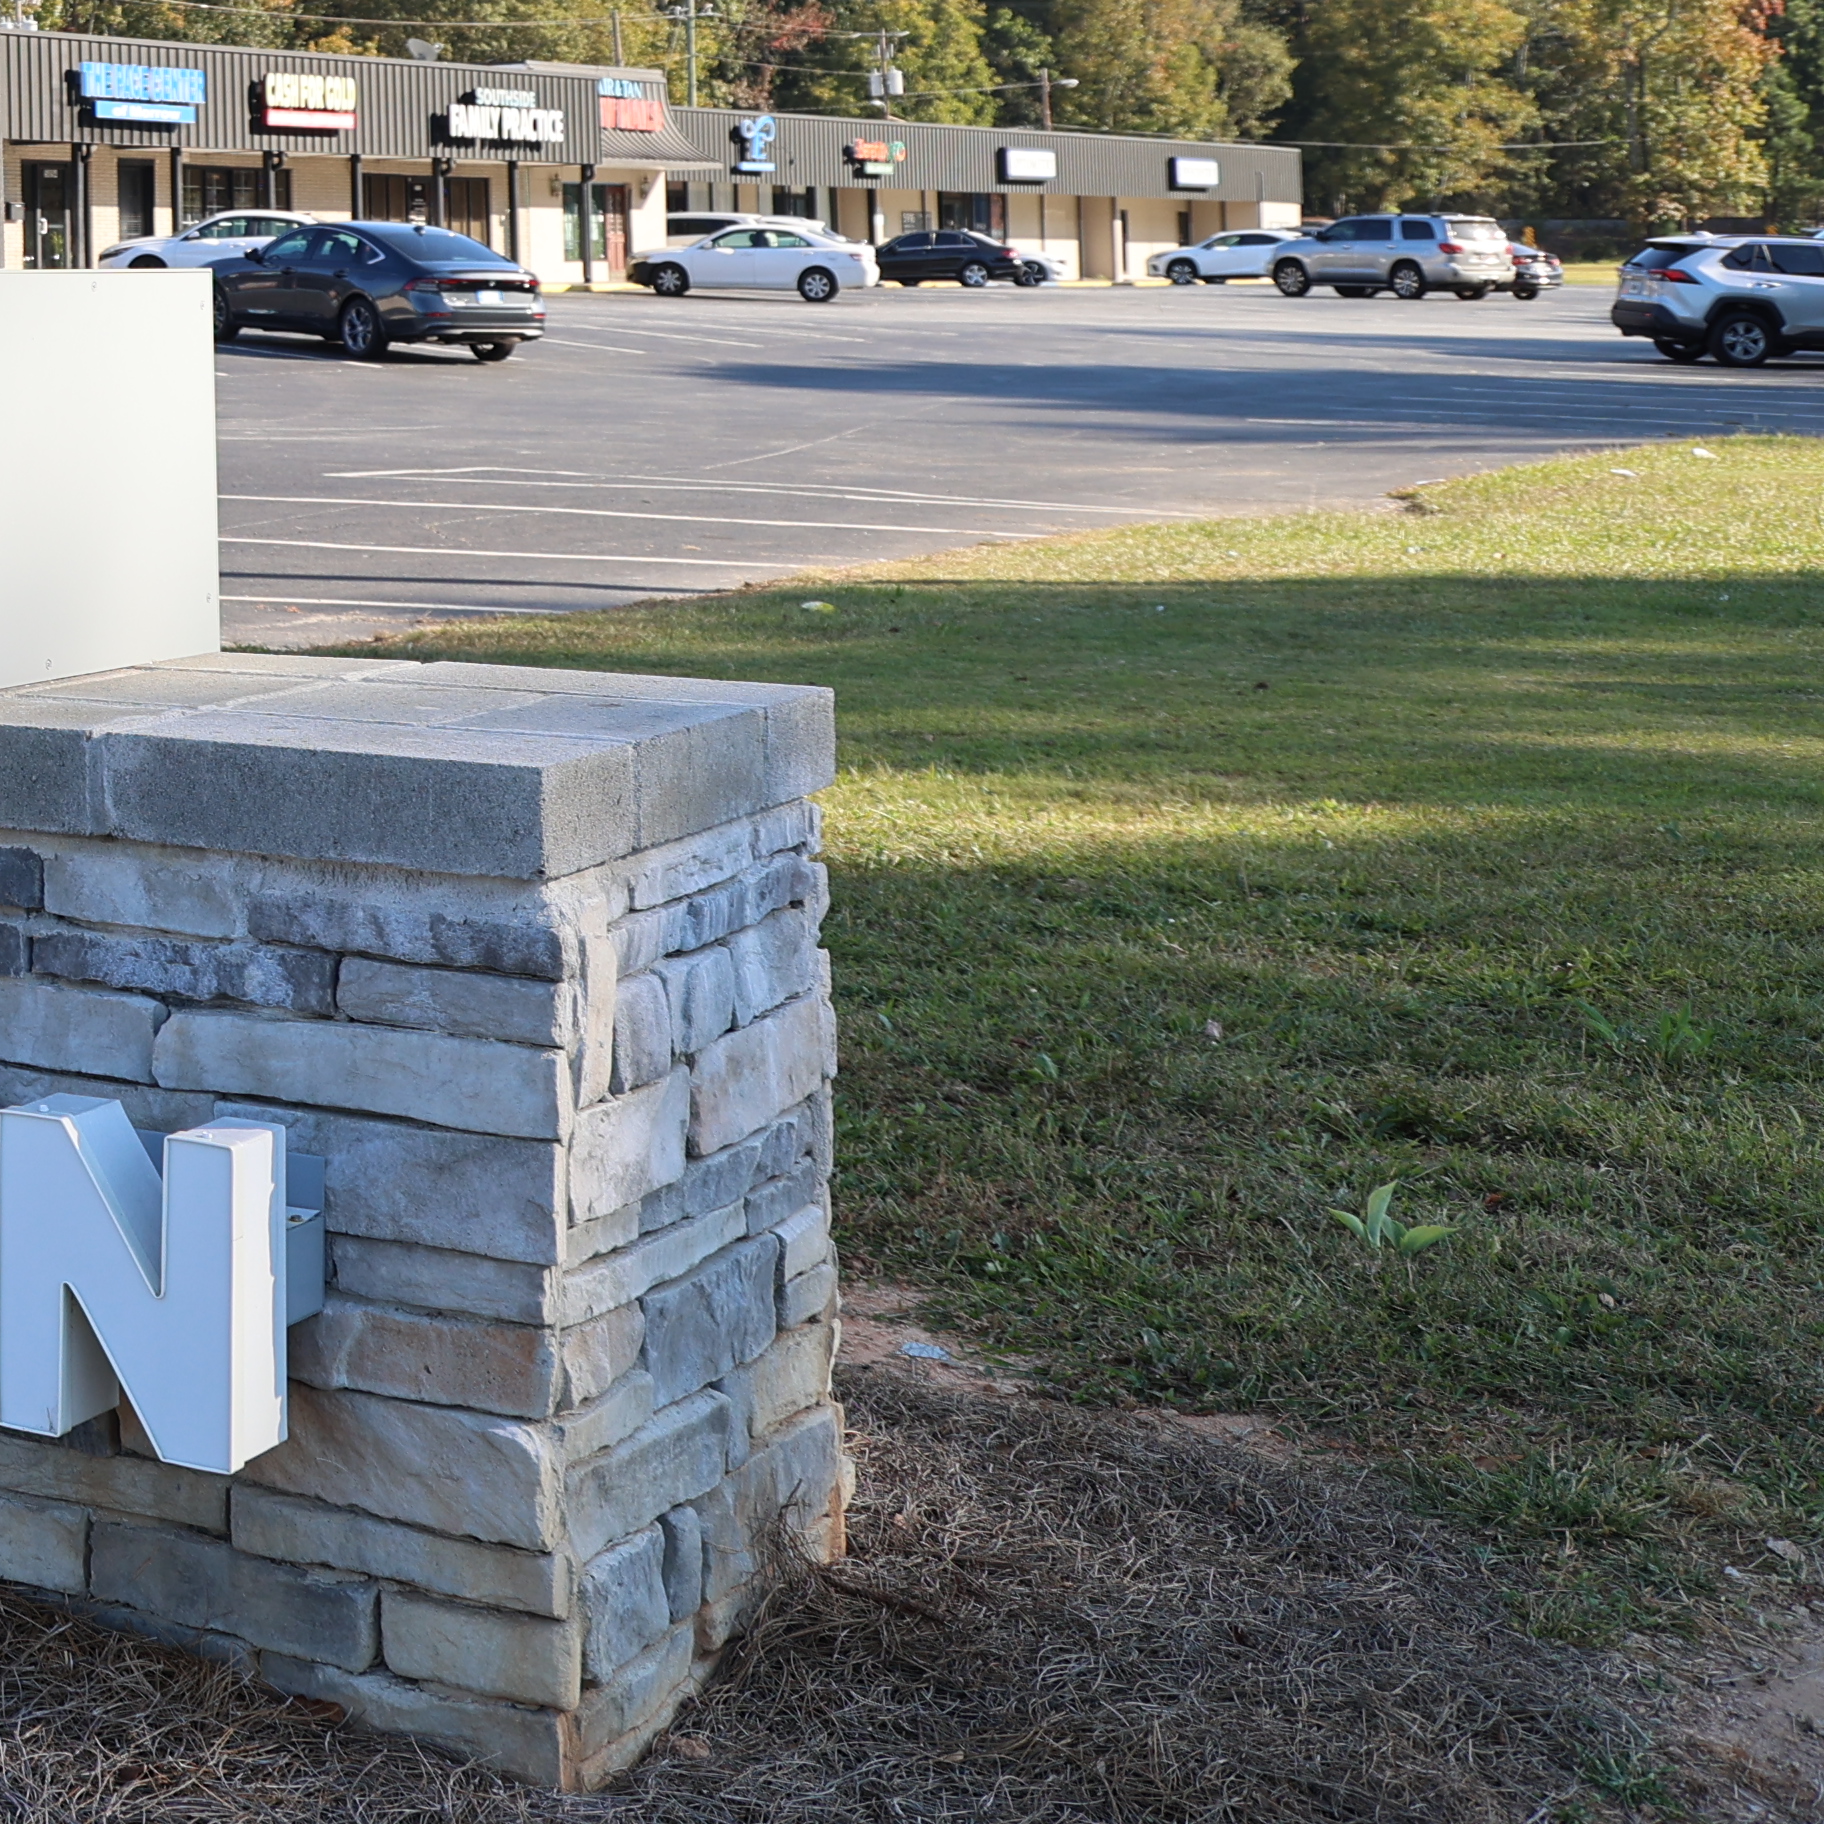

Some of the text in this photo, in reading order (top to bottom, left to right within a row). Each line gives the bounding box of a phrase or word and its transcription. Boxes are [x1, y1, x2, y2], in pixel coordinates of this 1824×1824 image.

[81, 62, 111, 97] THE
[149, 66, 205, 104] CENTER
[266, 72, 356, 111] CASH FOR GOLD
[475, 87, 536, 108] SOUTHSIDE
[449, 104, 501, 139] FAMILY
[501, 107, 564, 143] PRACTICE
